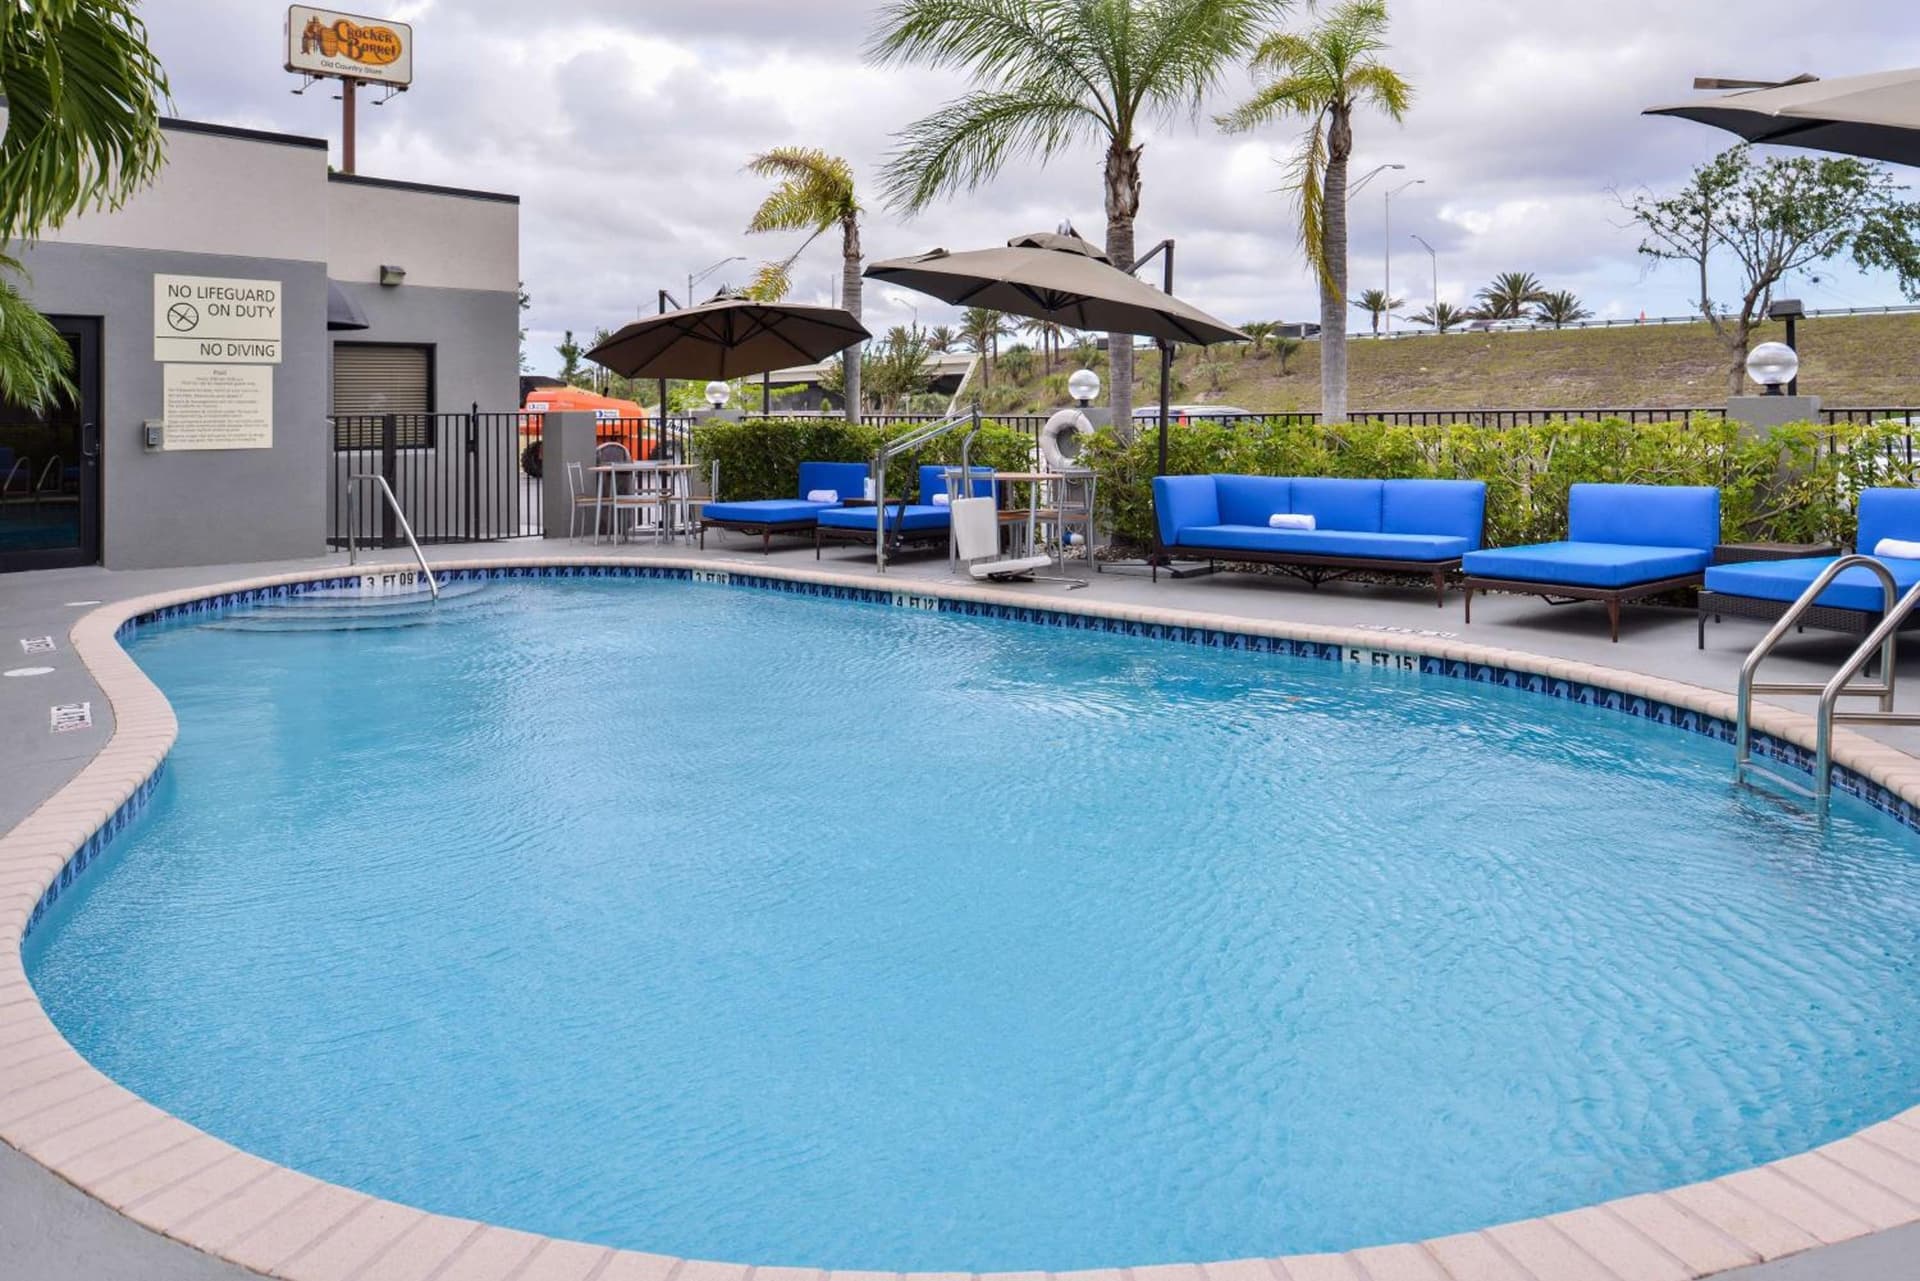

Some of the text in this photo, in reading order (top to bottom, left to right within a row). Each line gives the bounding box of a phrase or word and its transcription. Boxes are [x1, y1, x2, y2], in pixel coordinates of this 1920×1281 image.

[320, 60, 334, 69] Old
[335, 62, 364, 74] Country
[168, 284, 275, 302] NO LIFEGUARD
[208, 303, 275, 318] ON DUTY
[200, 343, 275, 357] NO DIVING
[367, 576, 375, 587] 3
[383, 574, 396, 586] FT
[910, 596, 920, 609] FT
[1350, 649, 1360, 664] 5
[1372, 651, 1389, 666] FT
